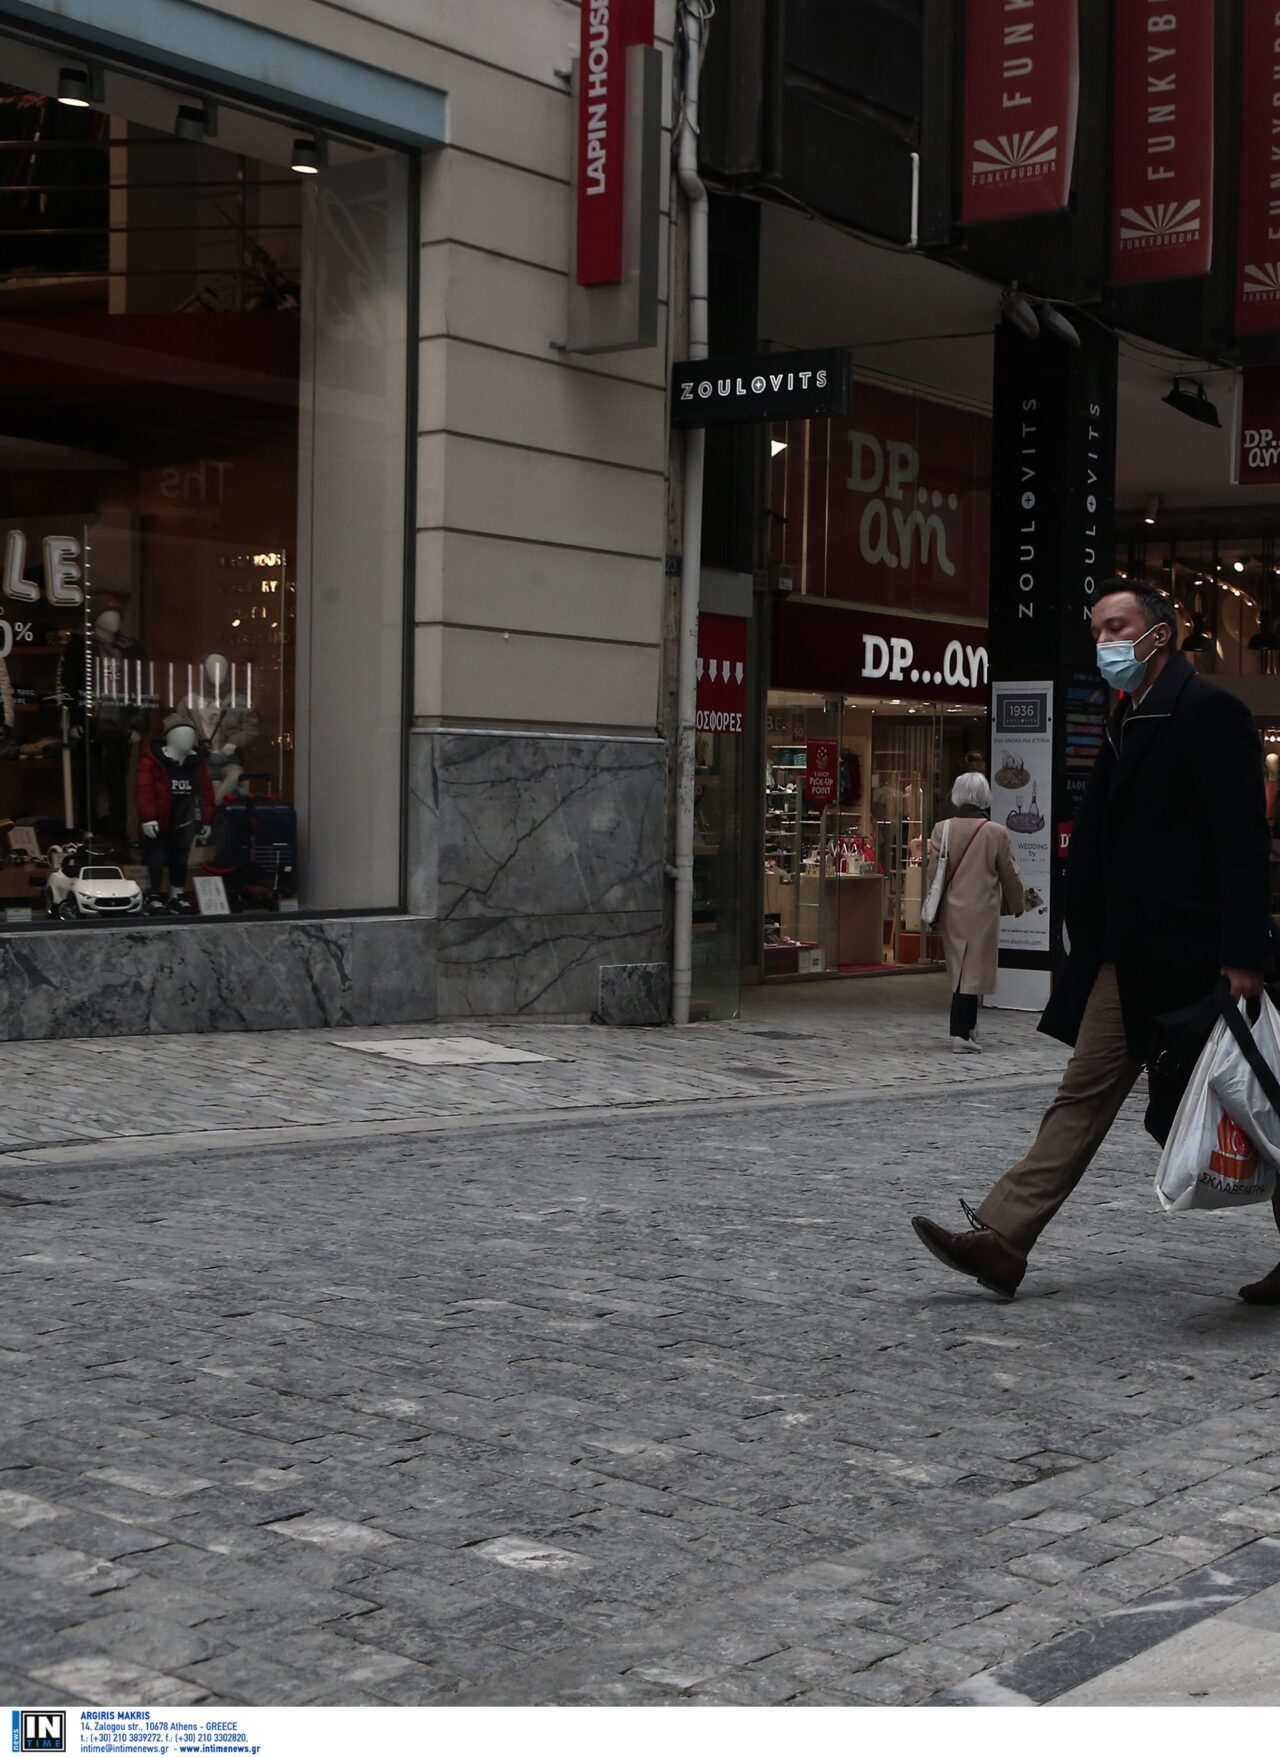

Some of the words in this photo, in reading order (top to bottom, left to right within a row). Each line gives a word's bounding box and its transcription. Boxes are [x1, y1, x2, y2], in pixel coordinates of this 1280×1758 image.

[1147, 0, 1177, 181] FUNKYB
[585, 103, 608, 196] LAPIN
[971, 161, 1057, 186] FUNKYBUDDHA
[1119, 231, 1200, 250] FUNKYBUDDHA
[680, 369, 828, 400] ZOULOVITS
[1018, 398, 1037, 619] ZOULOVITS
[1083, 403, 1100, 621] ZOULOVITS
[859, 498, 956, 577] am
[697, 709, 742, 732] ΟΣΦΟΡΕΣ
[1009, 705, 1034, 716] 1936
[809, 777, 834, 786] PICK-UP
[811, 787, 831, 795] POINT
